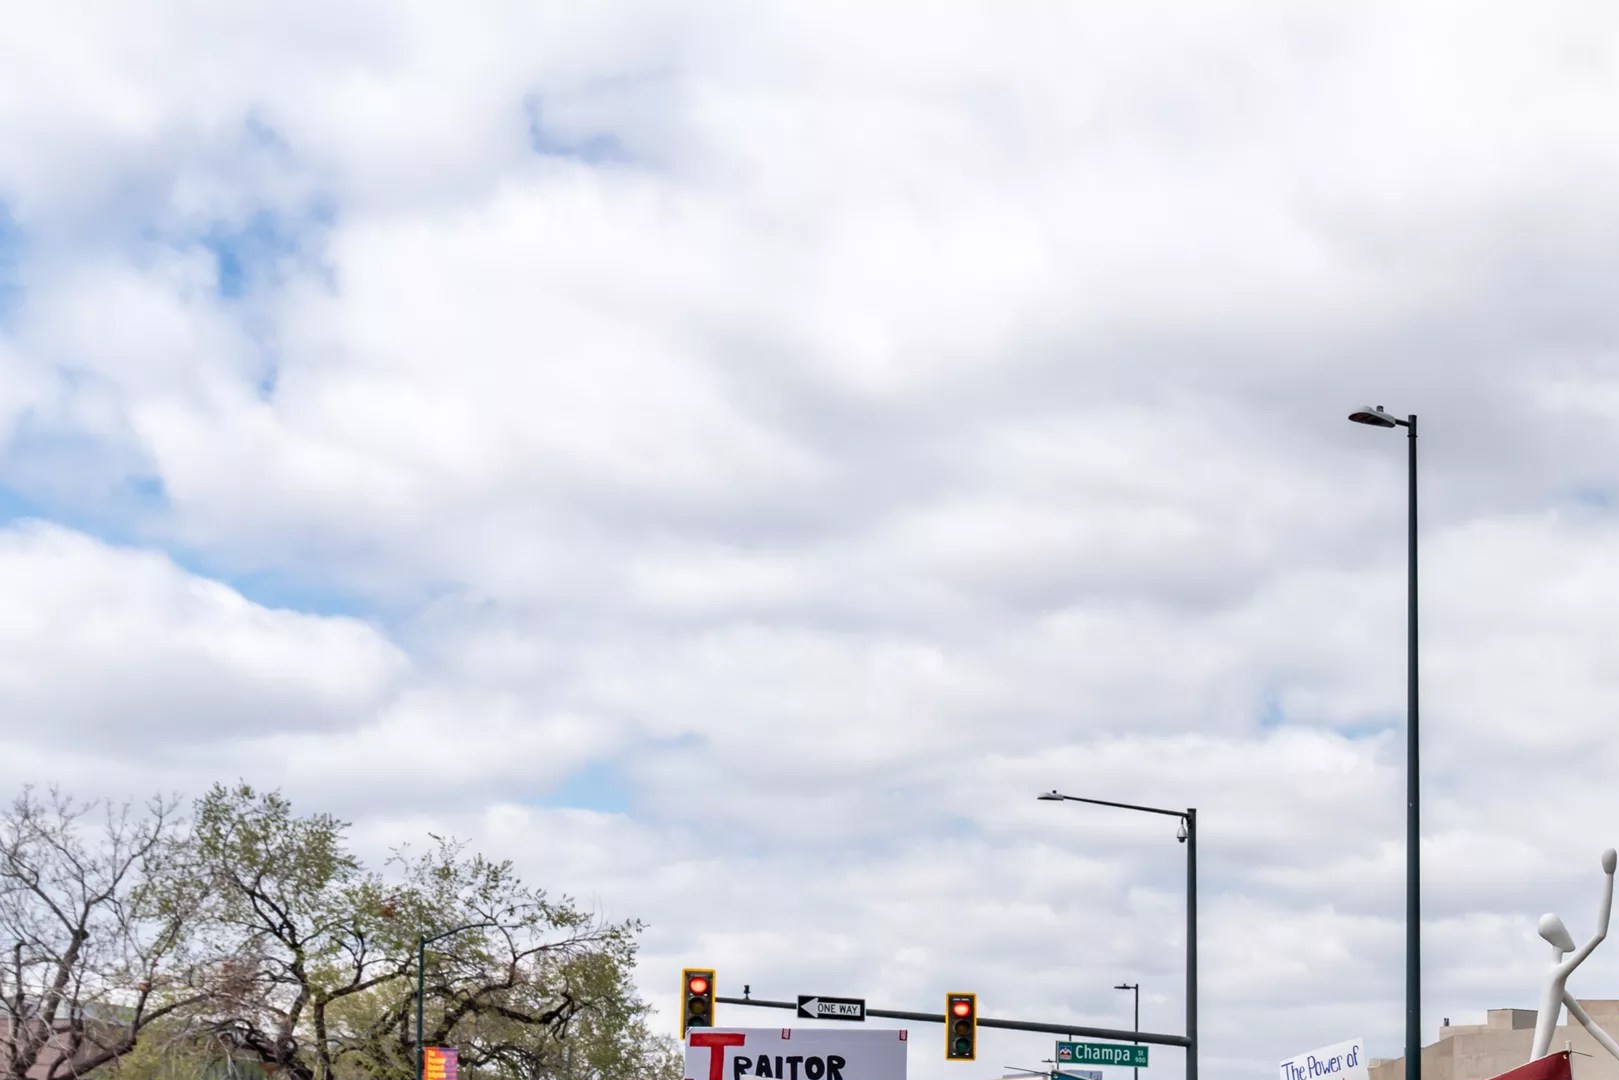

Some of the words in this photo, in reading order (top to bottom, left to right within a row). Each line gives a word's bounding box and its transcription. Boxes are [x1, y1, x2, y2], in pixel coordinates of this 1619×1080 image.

[817, 1003, 836, 1014] ONE
[838, 1004, 858, 1015] WAY
[1075, 1044, 1131, 1063] Champa
[1134, 1056, 1147, 1064] 900
[1307, 1055, 1343, 1079] Power
[1346, 1045, 1360, 1067] of
